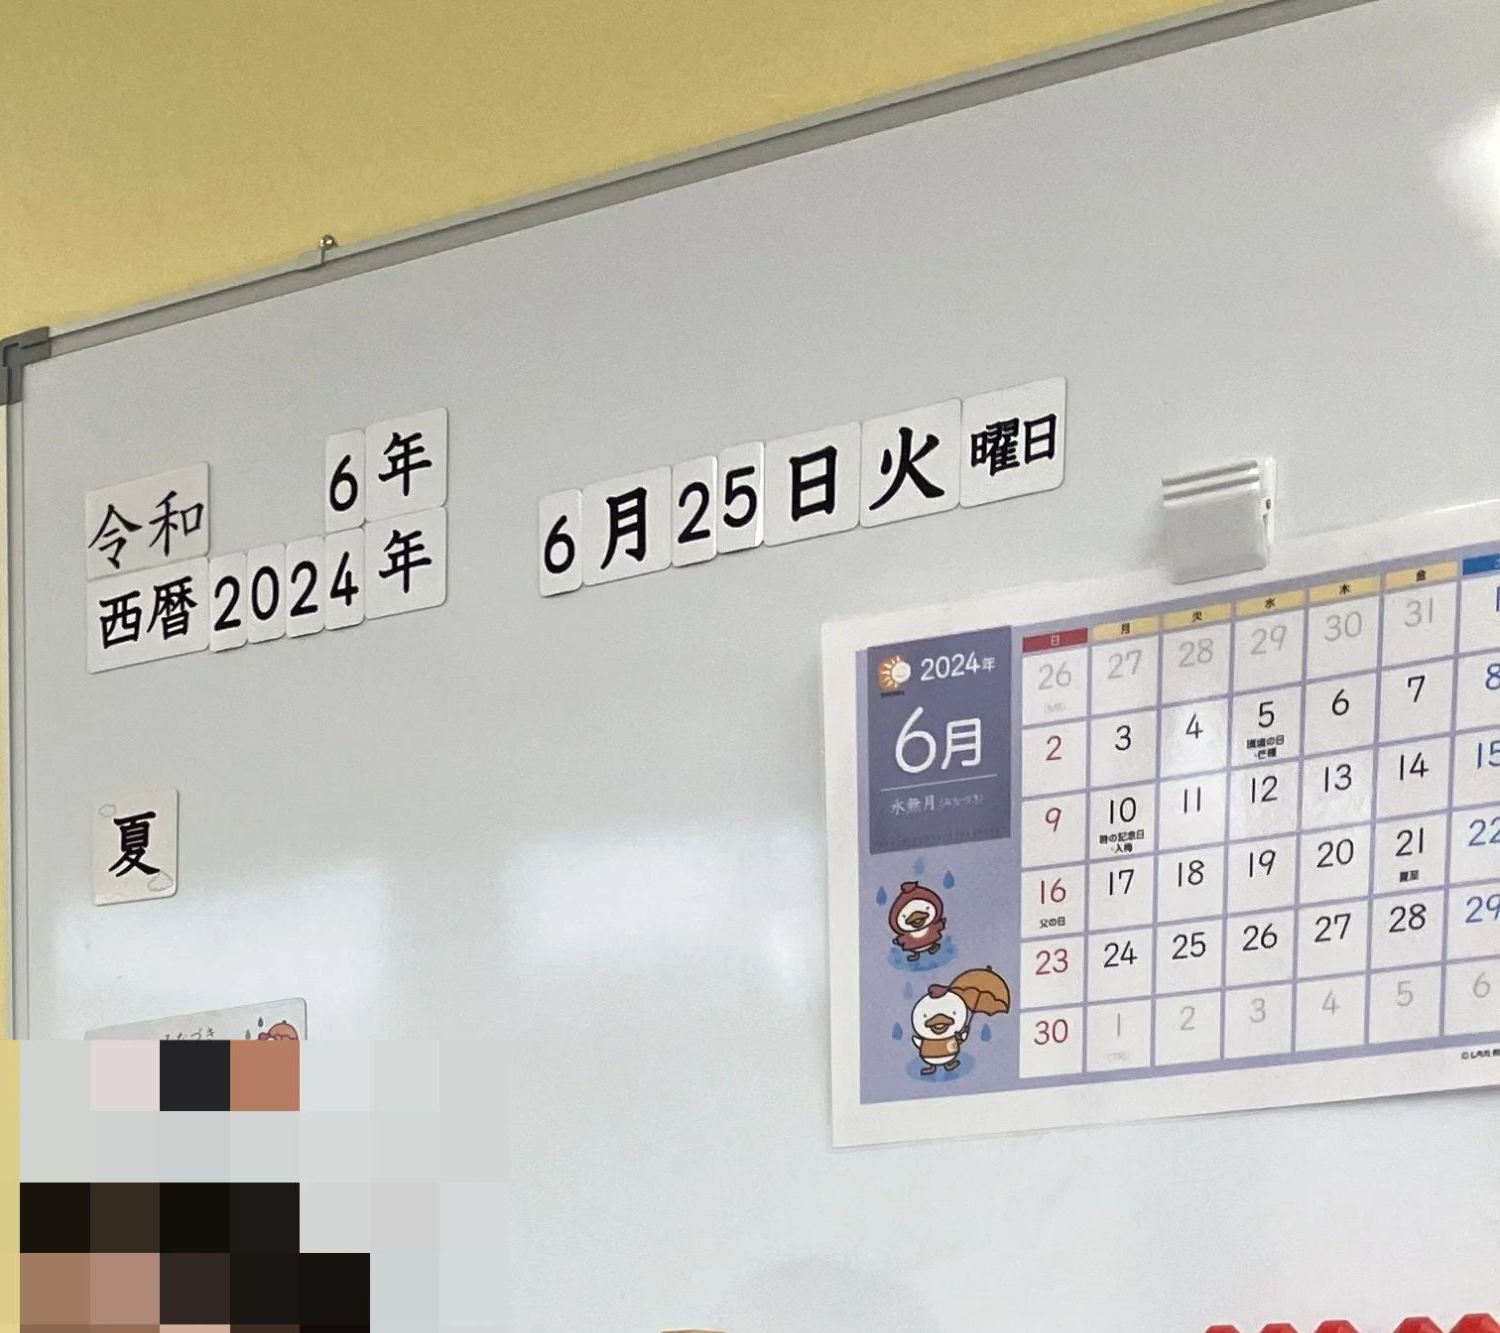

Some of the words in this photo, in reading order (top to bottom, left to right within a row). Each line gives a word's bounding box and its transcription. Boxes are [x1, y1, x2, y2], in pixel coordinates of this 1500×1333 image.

[88, 490, 204, 570] 令和
[329, 431, 432, 512] 6年
[543, 412, 1058, 574] 6月25日火曜日
[98, 529, 432, 649] 西暦2024年
[1050, 634, 1060, 647] 日
[1120, 622, 1131, 635] 月
[1192, 610, 1203, 622] 火
[1264, 597, 1276, 608] 水
[1339, 583, 1351, 595] 木
[920, 651, 996, 682] 2024年
[1038, 661, 1072, 690] 26
[1108, 650, 1142, 680] 27
[1178, 638, 1214, 668] 28
[1250, 625, 1287, 655] 29
[1324, 611, 1362, 641] 30
[1404, 597, 1433, 627] 31
[895, 706, 981, 774] 6月
[1046, 735, 1062, 761] 2
[1114, 725, 1132, 751] 3
[1185, 713, 1203, 739] 4
[1258, 701, 1274, 728] 5
[1331, 689, 1349, 716] 6
[1407, 675, 1425, 702] 7
[1486, 663, 1500, 690] 8
[1045, 807, 1062, 832] 9
[1109, 797, 1137, 824] 10
[1184, 786, 1201, 813] 11
[1252, 776, 1277, 804] 12
[1324, 763, 1352, 793] 13
[1399, 752, 1429, 781] 14
[1478, 741, 1500, 769] 15
[109, 811, 160, 878] 夏
[1041, 878, 1067, 905] 16
[1108, 869, 1135, 896] 17
[1178, 859, 1205, 887] 18
[1249, 849, 1276, 878] 19
[1316, 838, 1354, 868] 20
[1395, 827, 1424, 857] 21
[1468, 816, 1500, 847] 22
[1035, 948, 1069, 976] 23
[1103, 940, 1138, 968] 24
[1171, 931, 1206, 960] 25
[1242, 923, 1278, 952] 26
[1314, 912, 1351, 943] 27
[1389, 903, 1426, 933] 28
[1465, 894, 1500, 923] 29
[1033, 1018, 1069, 1045] 30
[1116, 1012, 1121, 1037] 1
[1180, 1005, 1196, 1031] 2
[1249, 998, 1266, 1023] 3
[1322, 990, 1340, 1015] 4
[1396, 980, 1413, 1007] 5
[1472, 971, 1491, 999] 6
